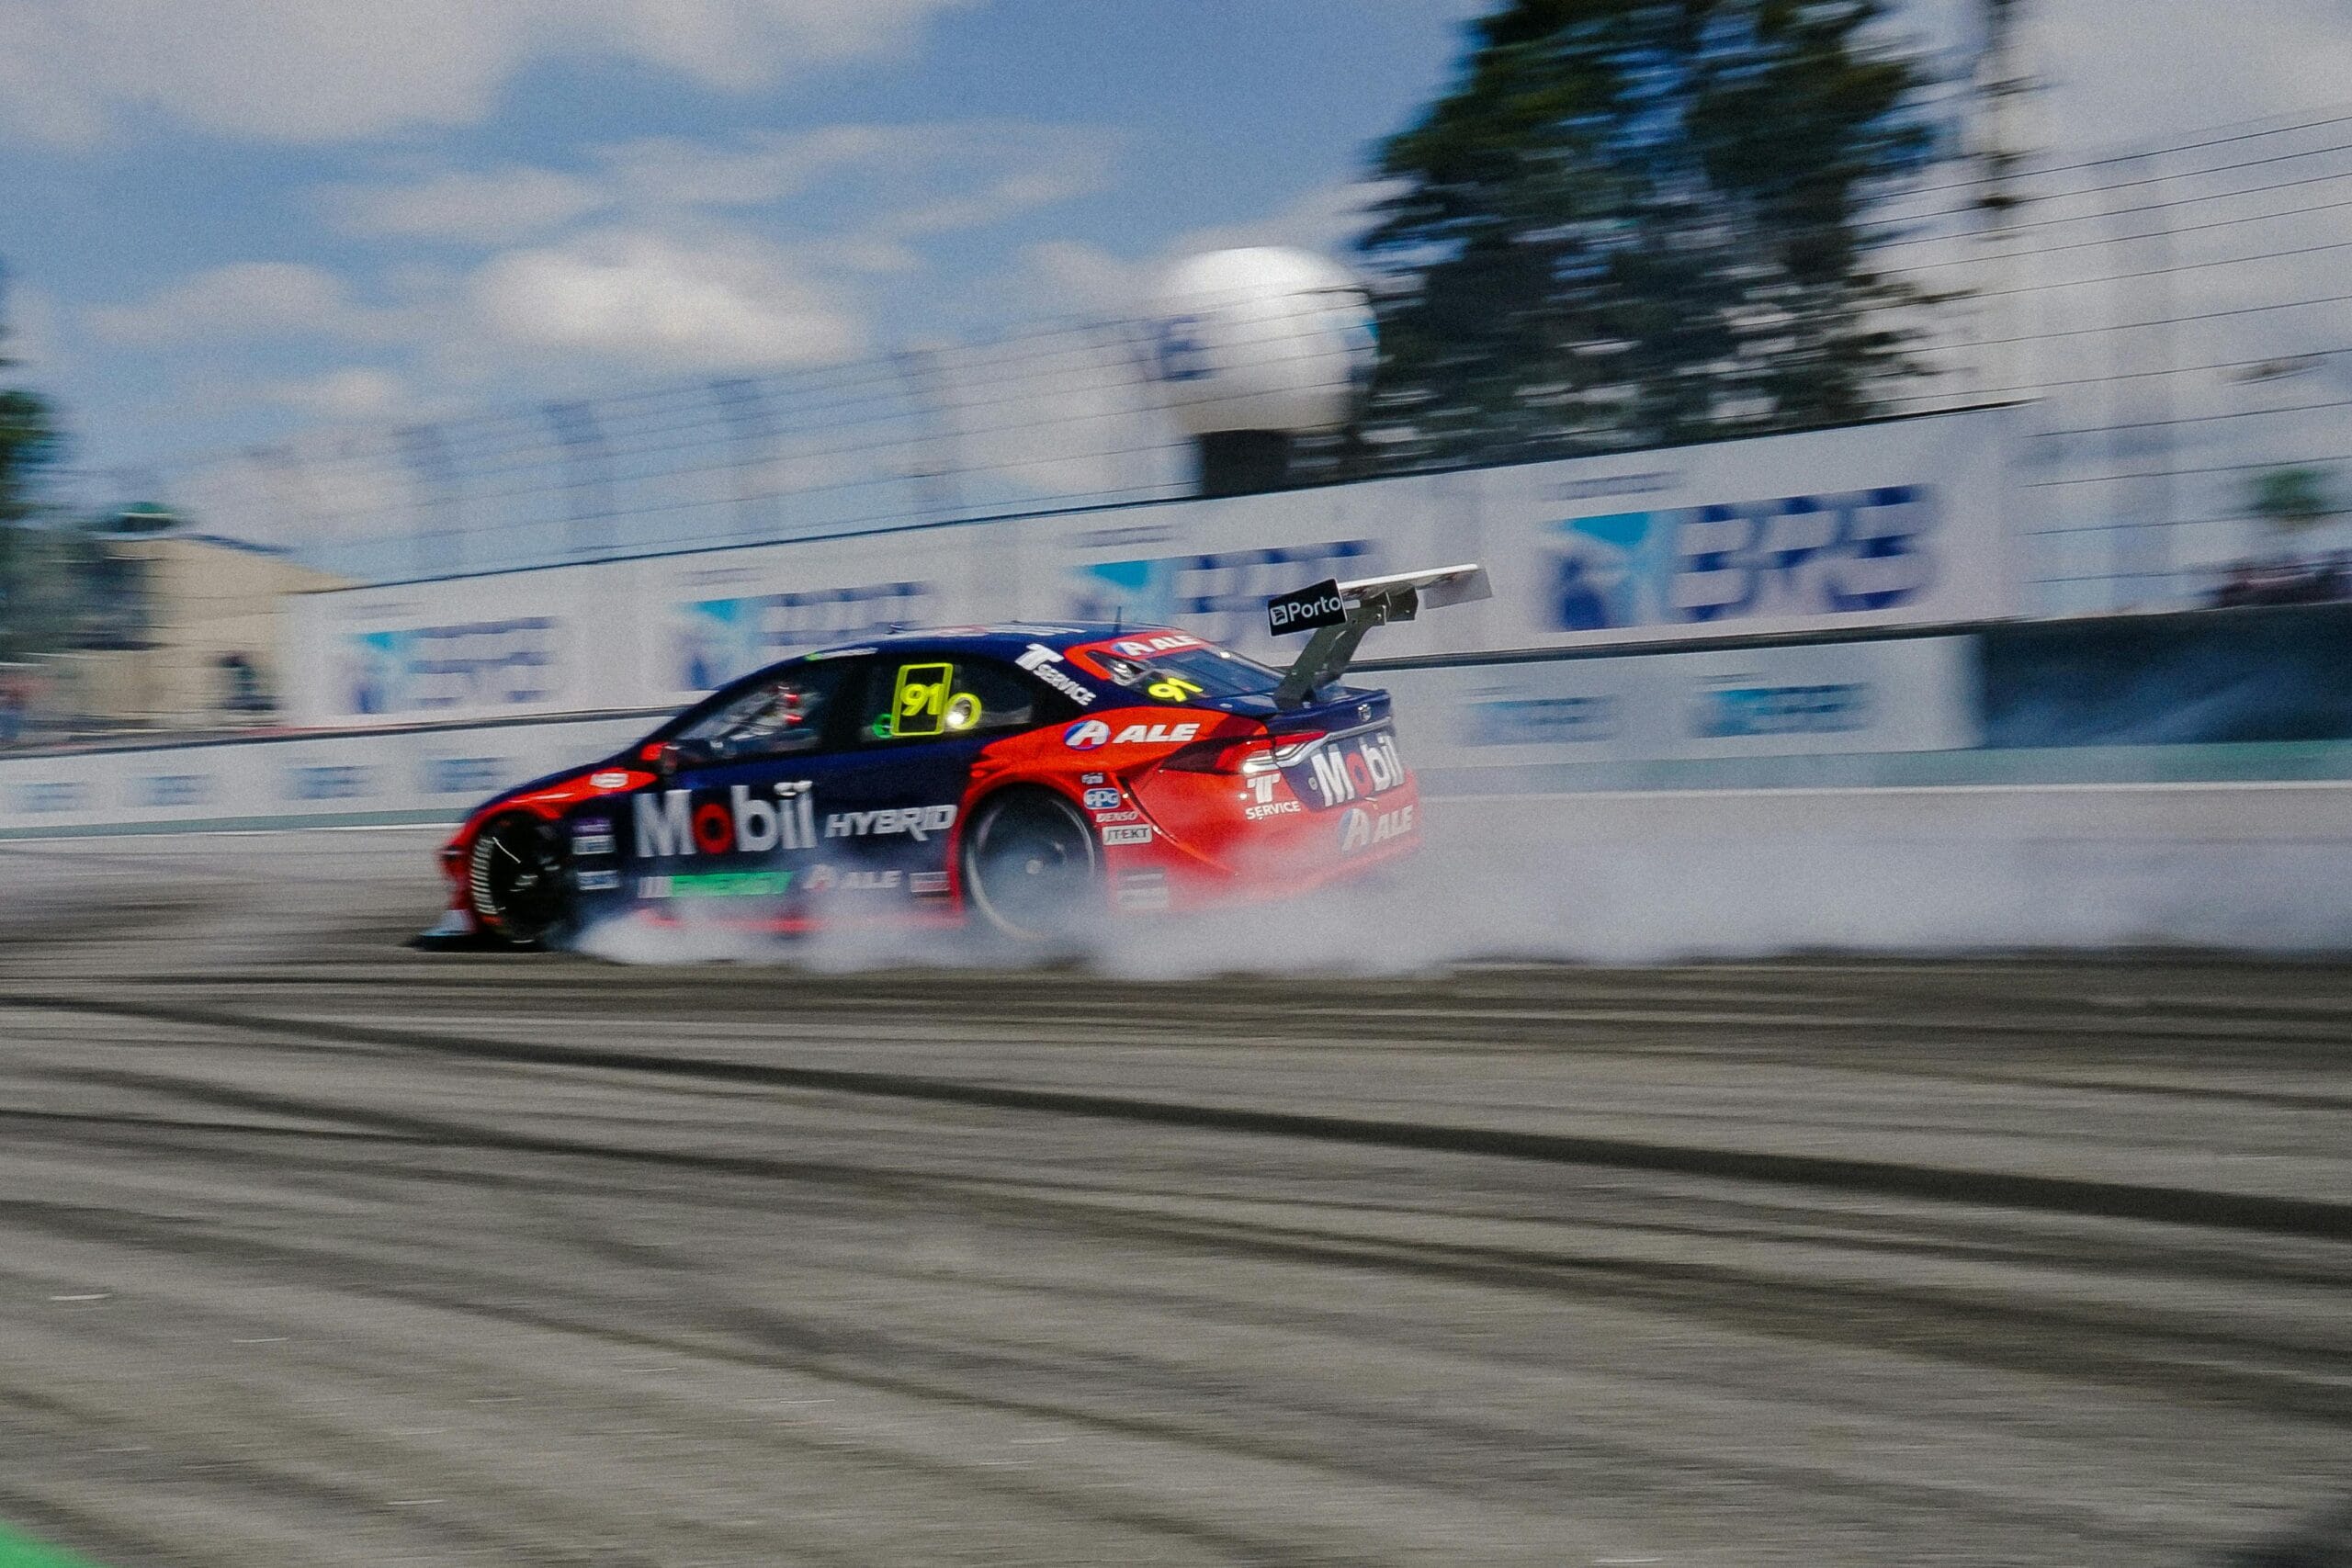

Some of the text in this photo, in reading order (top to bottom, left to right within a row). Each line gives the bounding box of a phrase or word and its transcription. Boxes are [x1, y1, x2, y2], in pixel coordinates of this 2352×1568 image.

[1287, 595, 1342, 622] Porto
[1149, 635, 1200, 651] ALE
[1033, 663, 1097, 706] SERVICE
[1148, 677, 1204, 703] 91
[899, 683, 944, 716] 91
[1113, 723, 1201, 744] ALE
[1309, 732, 1407, 807] Mobil
[1087, 791, 1119, 807] PPG
[1245, 800, 1301, 820] SERVICE
[632, 781, 819, 857] Mobil
[825, 804, 957, 841] HYBRID
[1096, 812, 1138, 822] DENSO
[1373, 805, 1413, 843] ALE
[1107, 829, 1148, 841] JTEKT
[840, 871, 901, 889] ALE
